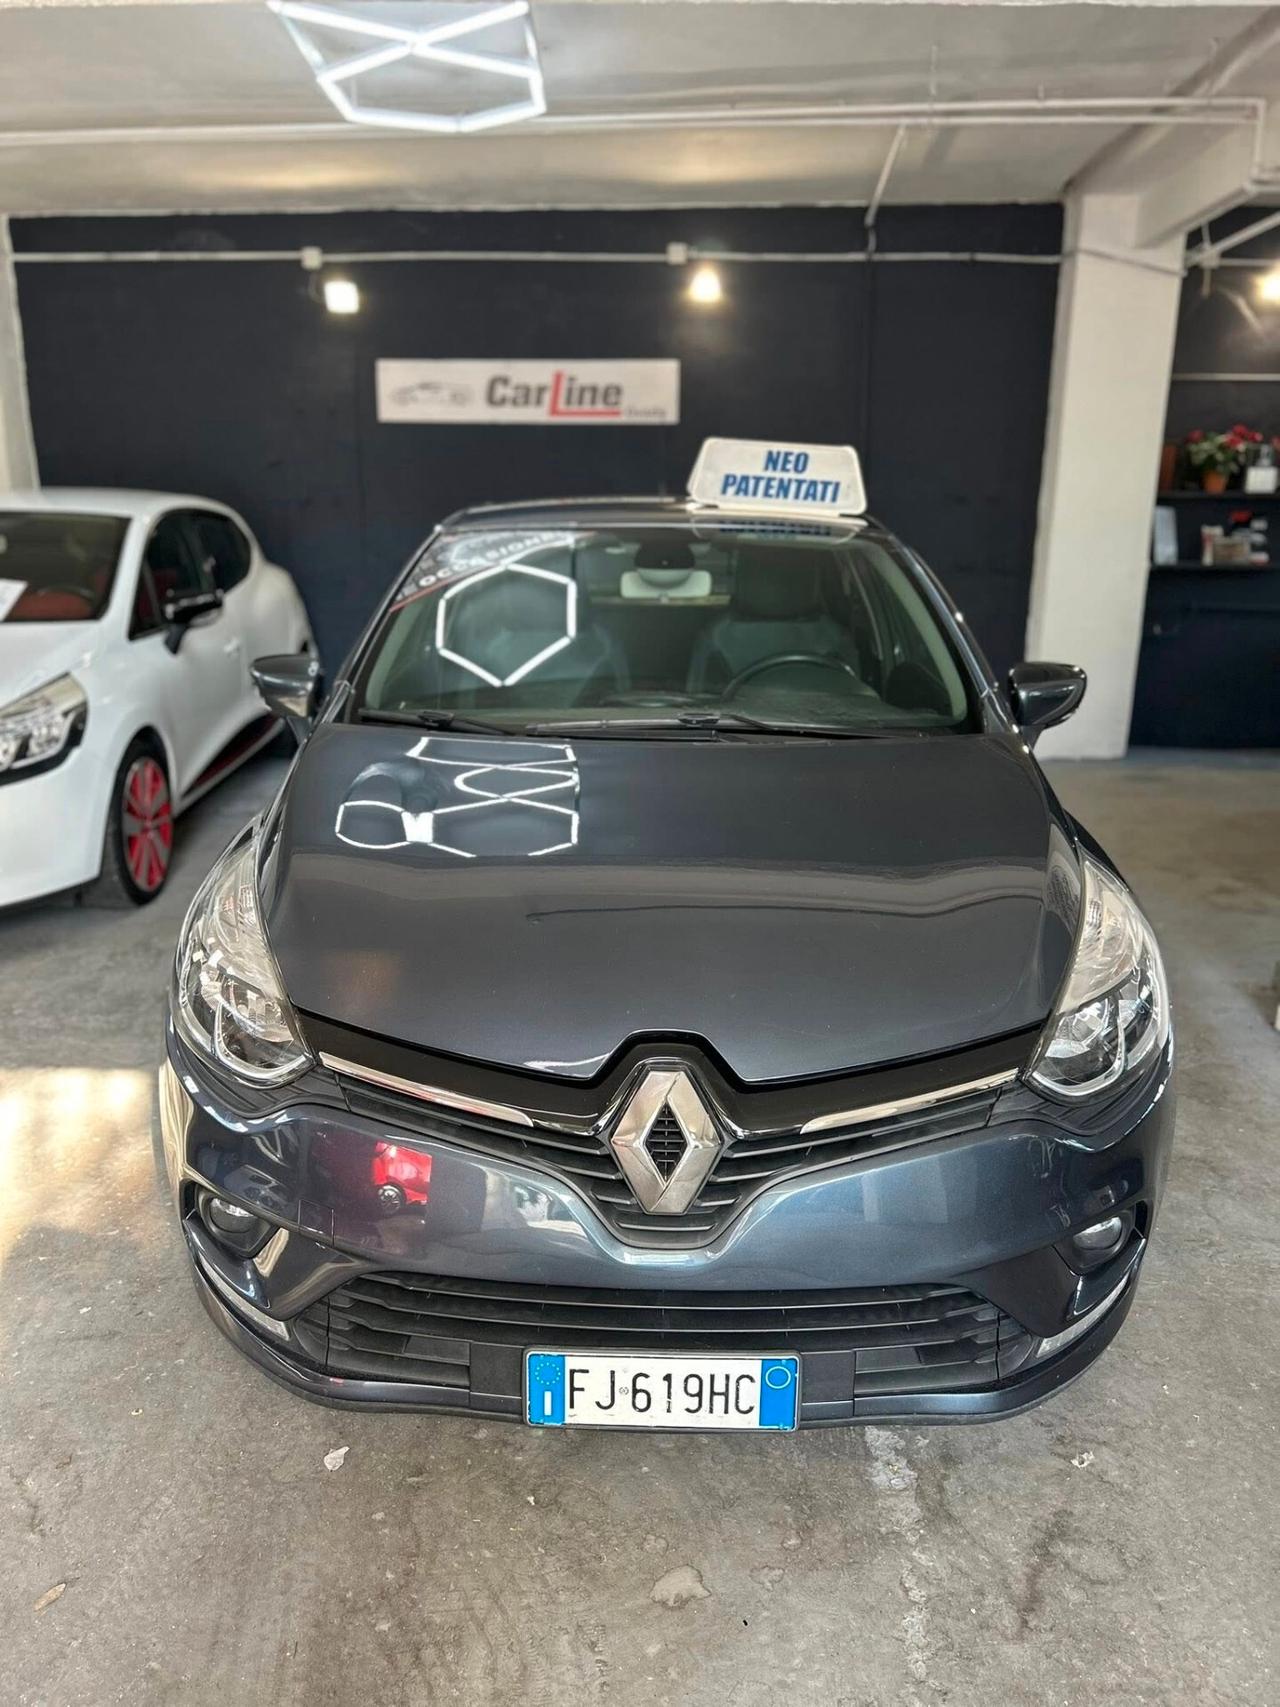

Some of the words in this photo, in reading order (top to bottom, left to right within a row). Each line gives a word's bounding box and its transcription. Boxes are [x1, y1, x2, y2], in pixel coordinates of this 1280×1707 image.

[486, 370, 622, 417] CarLine
[764, 449, 809, 474] NEO
[721, 473, 841, 503] PATENTATI
